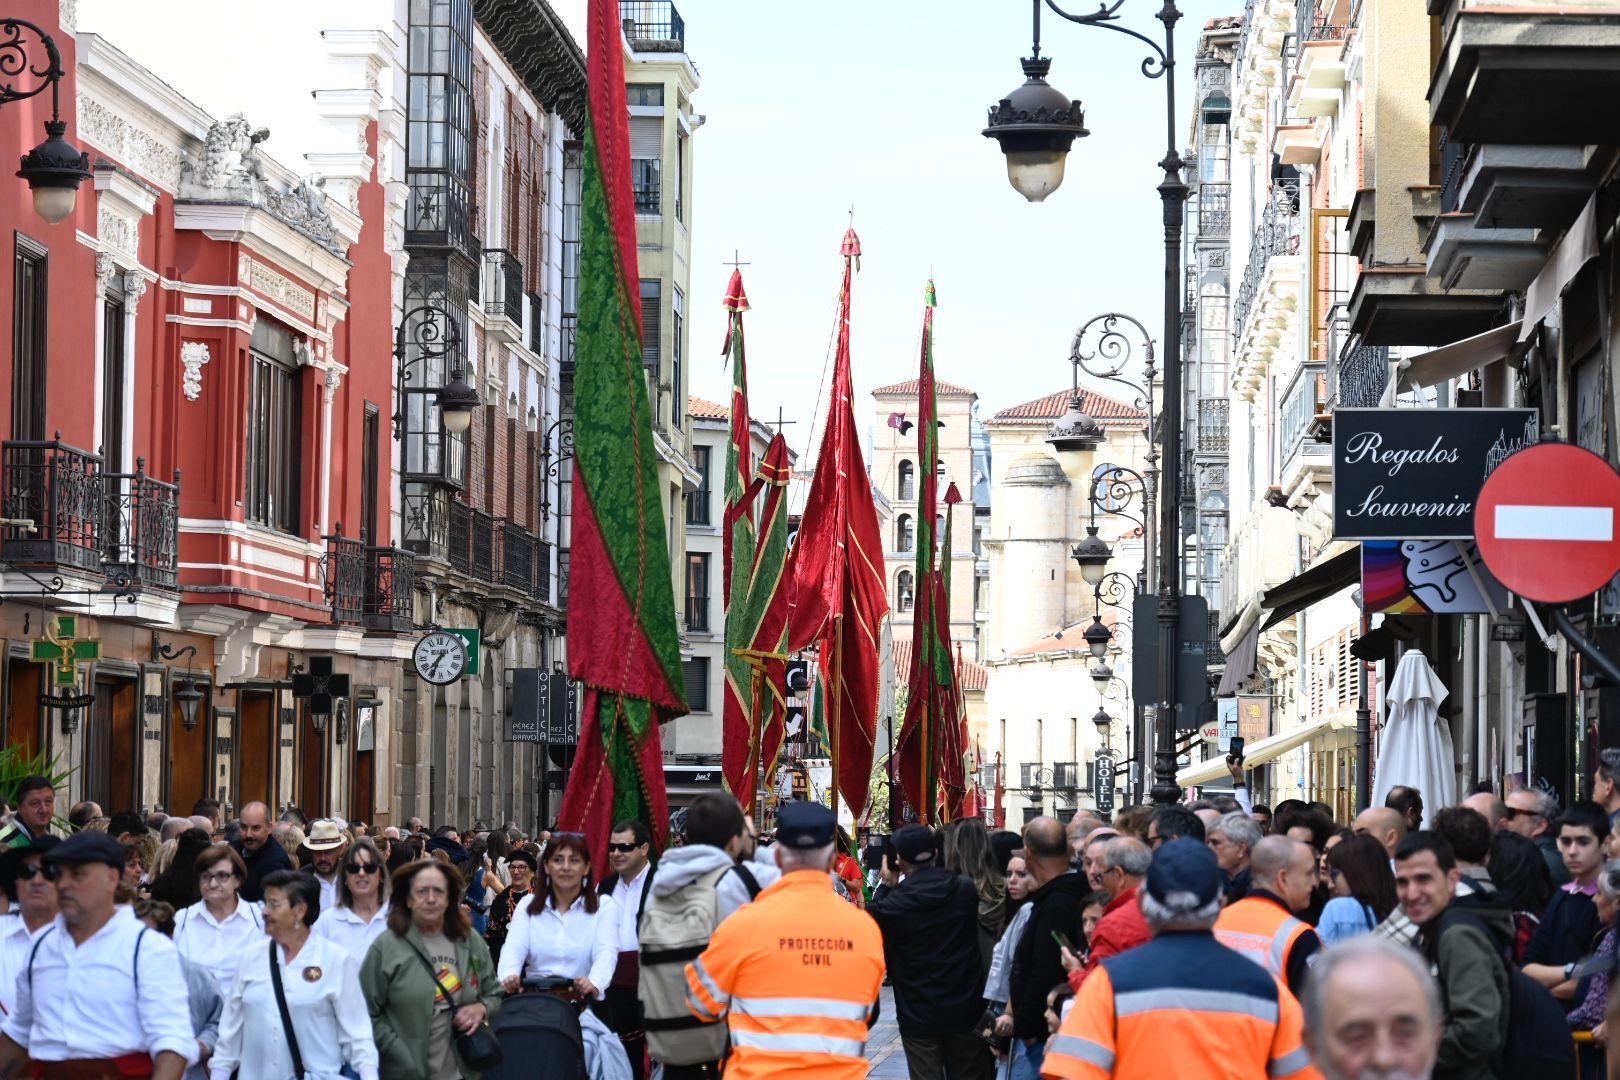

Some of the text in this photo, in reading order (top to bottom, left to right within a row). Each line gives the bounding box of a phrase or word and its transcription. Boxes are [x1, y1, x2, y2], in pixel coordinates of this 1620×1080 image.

[1344, 431, 1460, 477] Regalos
[1346, 484, 1472, 517] Souvenir
[1098, 760, 1110, 803] HOTEL
[779, 936, 854, 952] PROTECCIÓN
[802, 953, 831, 967] CIVIL
